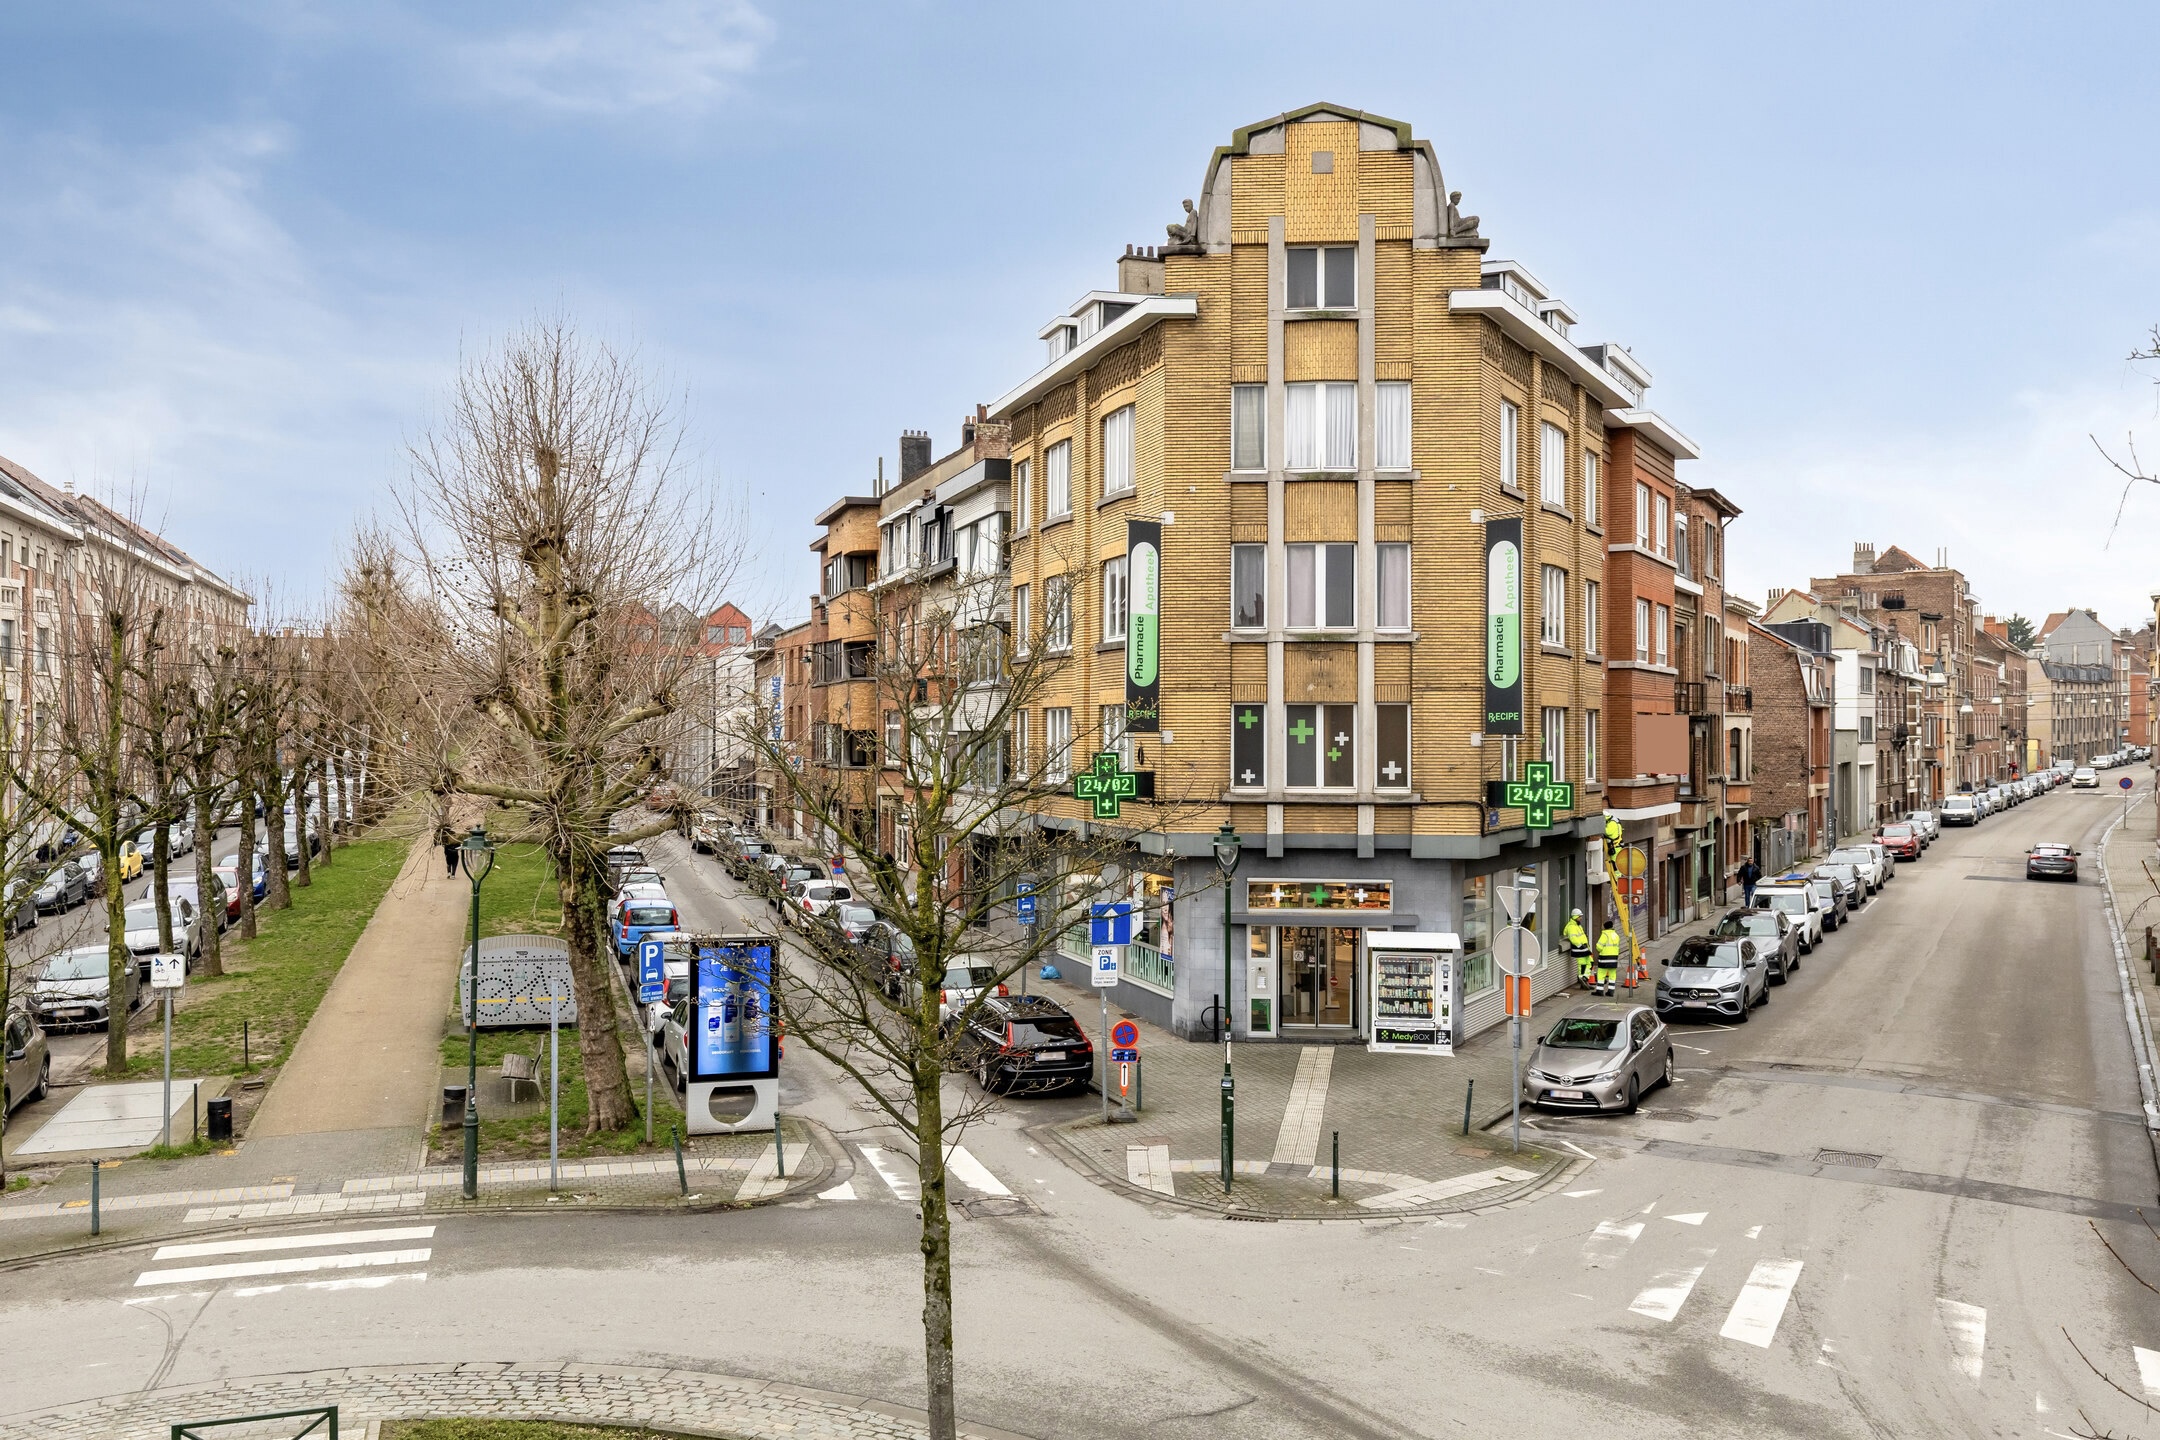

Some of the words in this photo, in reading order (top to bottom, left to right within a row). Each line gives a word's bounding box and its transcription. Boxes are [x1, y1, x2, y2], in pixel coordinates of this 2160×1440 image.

[1145, 550, 1155, 610] Apotheek
[1505, 547, 1515, 610] Apotheek
[1134, 615, 1144, 680] Pharmacie
[1494, 616, 1504, 681] Pharmacie
[1083, 779, 1130, 792] 24/02
[1513, 788, 1564, 802] 24/02
[645, 944, 659, 968] P
[1101, 957, 1110, 969] P
[1392, 1032, 1430, 1042] MedyBOX
